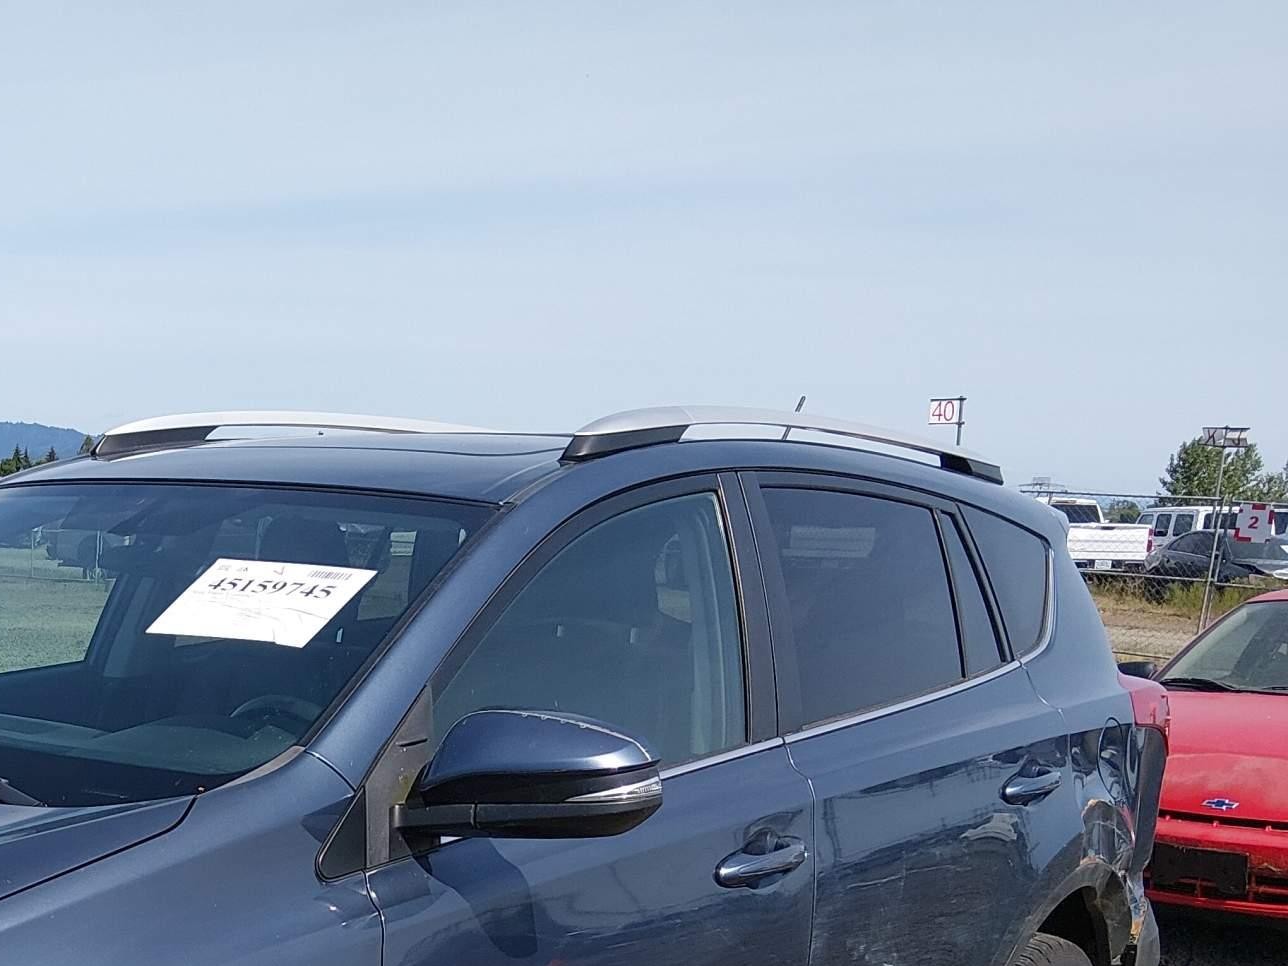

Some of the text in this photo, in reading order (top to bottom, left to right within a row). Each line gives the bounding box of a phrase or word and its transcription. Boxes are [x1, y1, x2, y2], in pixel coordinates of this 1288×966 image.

[931, 400, 955, 422] 40
[1247, 515, 1260, 530] 2
[207, 576, 338, 600] 45159745
